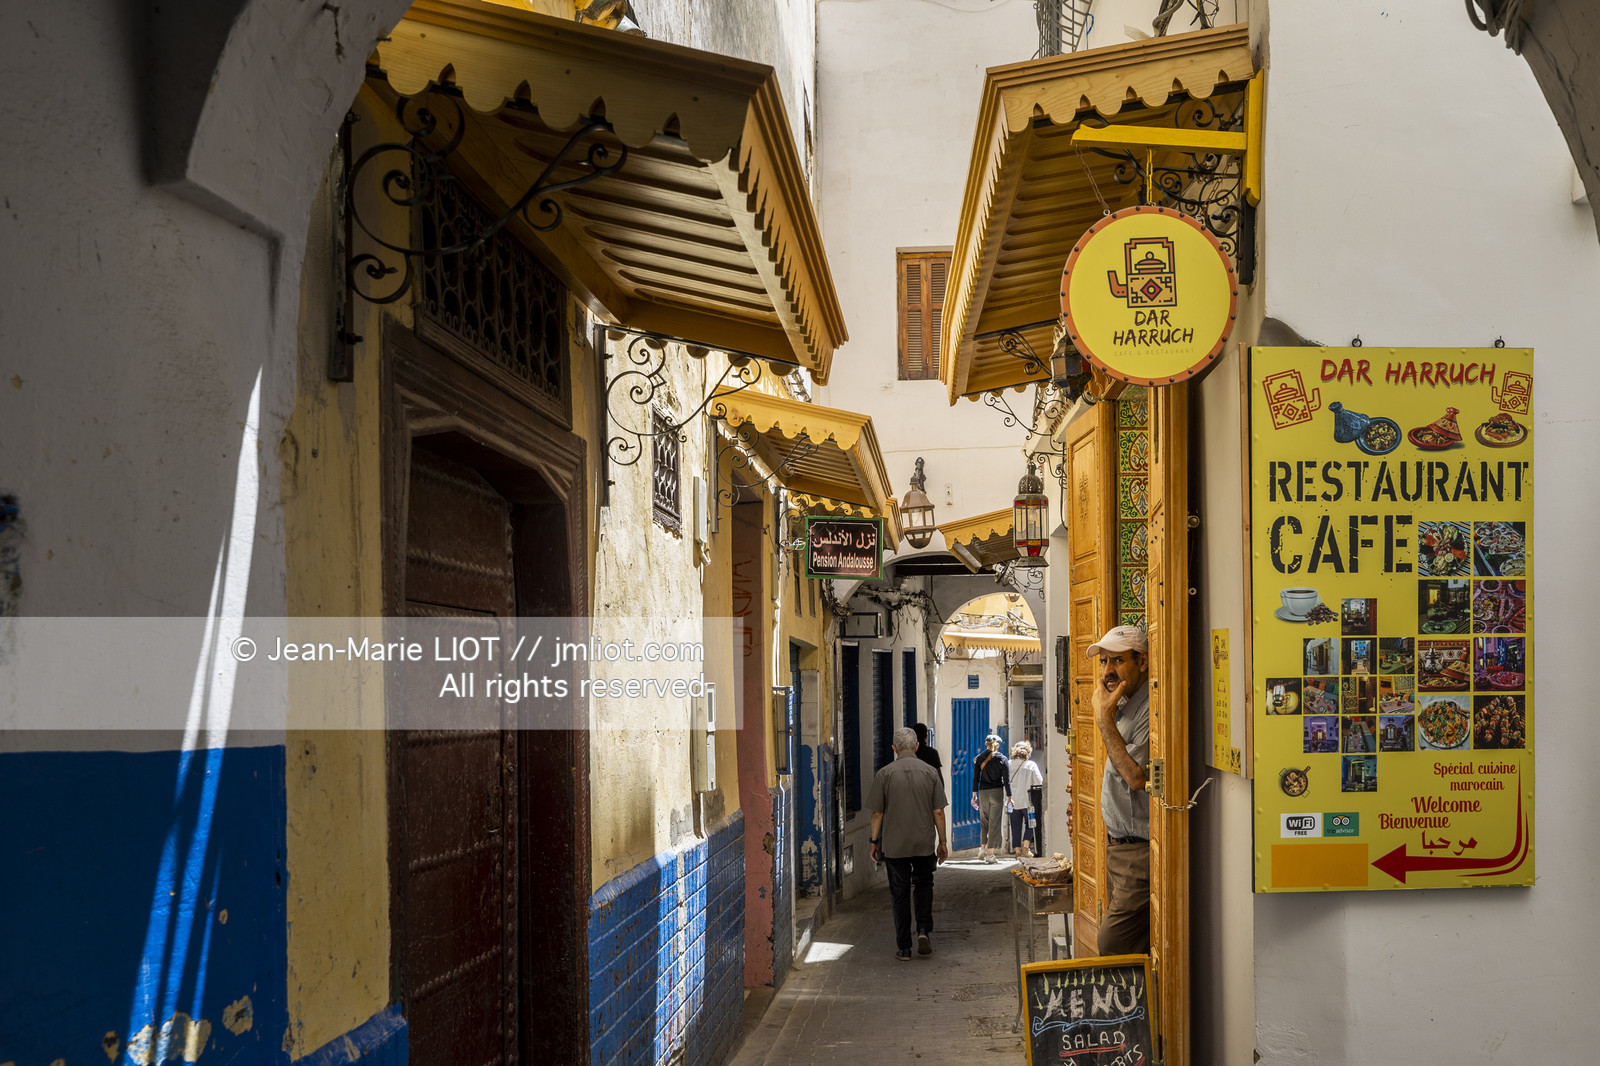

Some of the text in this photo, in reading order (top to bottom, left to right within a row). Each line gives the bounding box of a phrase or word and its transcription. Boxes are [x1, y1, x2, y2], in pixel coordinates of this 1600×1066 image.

[1135, 310, 1172, 328] DAR
[1113, 328, 1194, 348] HARRUCH
[1320, 358, 1496, 388] DAR HARRUCH
[1269, 461, 1529, 502] RESTAURANT
[856, 531, 876, 550] نزل
[1270, 515, 1412, 574] CAFE
[812, 551, 874, 569] Pension Andalousse
[1433, 762, 1518, 778] Spécial cuisine
[1450, 778, 1504, 791] marocain
[1411, 796, 1482, 814] Welcome
[1378, 813, 1451, 830] Bienvenue
[1421, 830, 1478, 856] مرحبا
[1042, 985, 1137, 1022] MENU
[1062, 1030, 1126, 1051] SALAD
